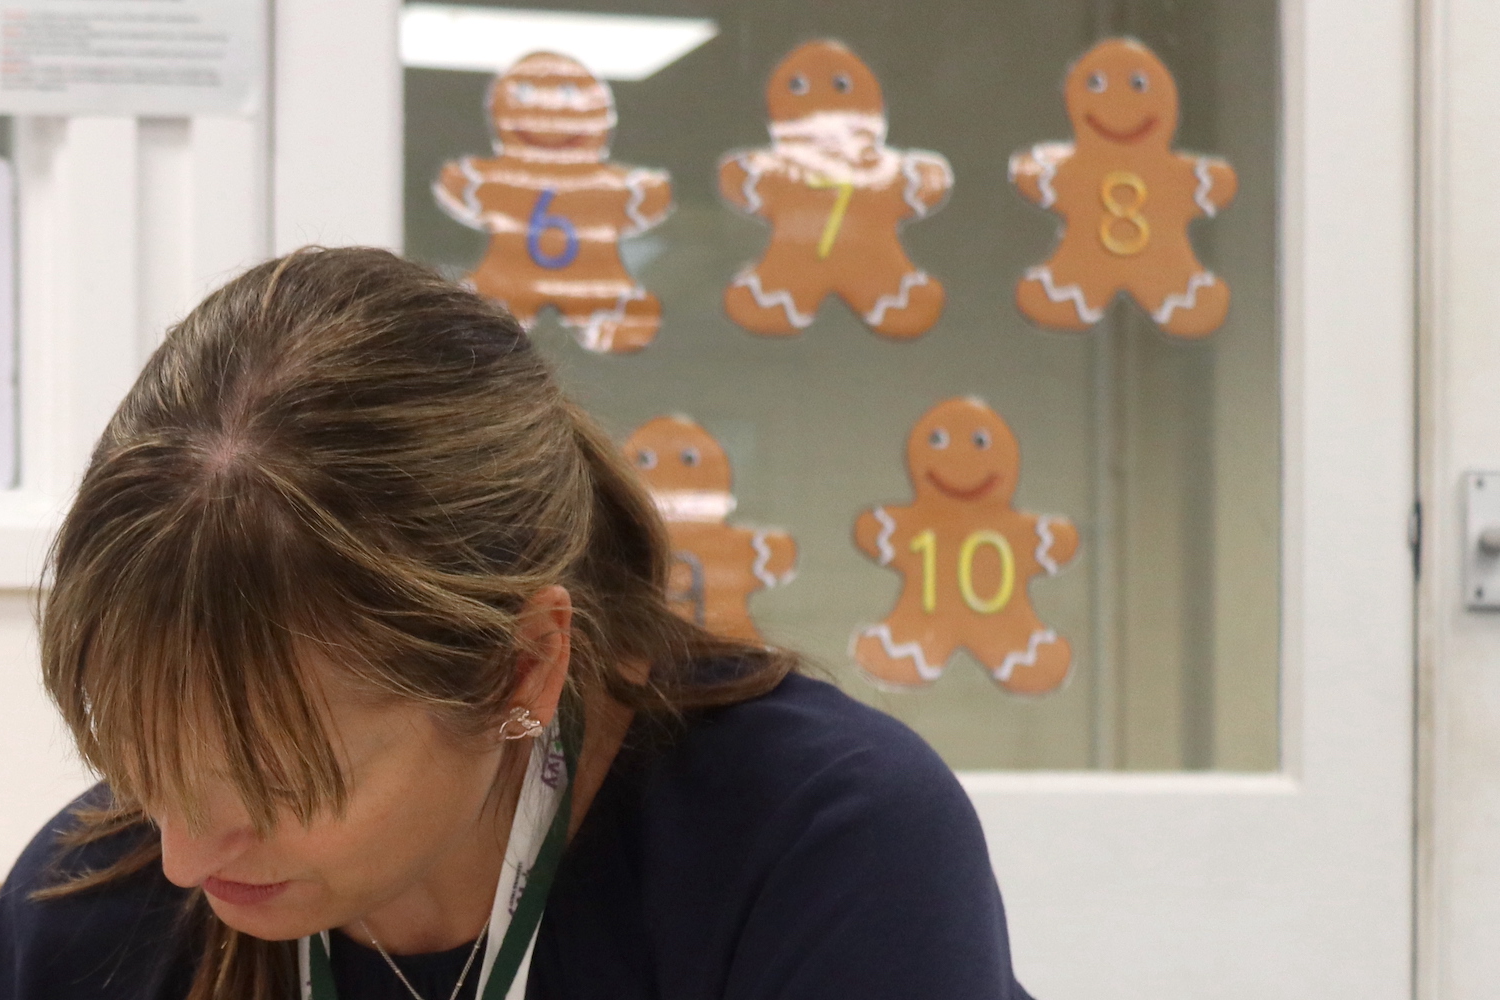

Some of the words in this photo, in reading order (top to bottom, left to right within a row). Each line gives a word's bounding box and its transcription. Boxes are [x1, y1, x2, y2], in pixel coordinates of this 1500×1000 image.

[527, 187, 580, 270] 6
[806, 174, 855, 260] 7
[1099, 170, 1150, 256] 8
[909, 529, 1015, 615] 10
